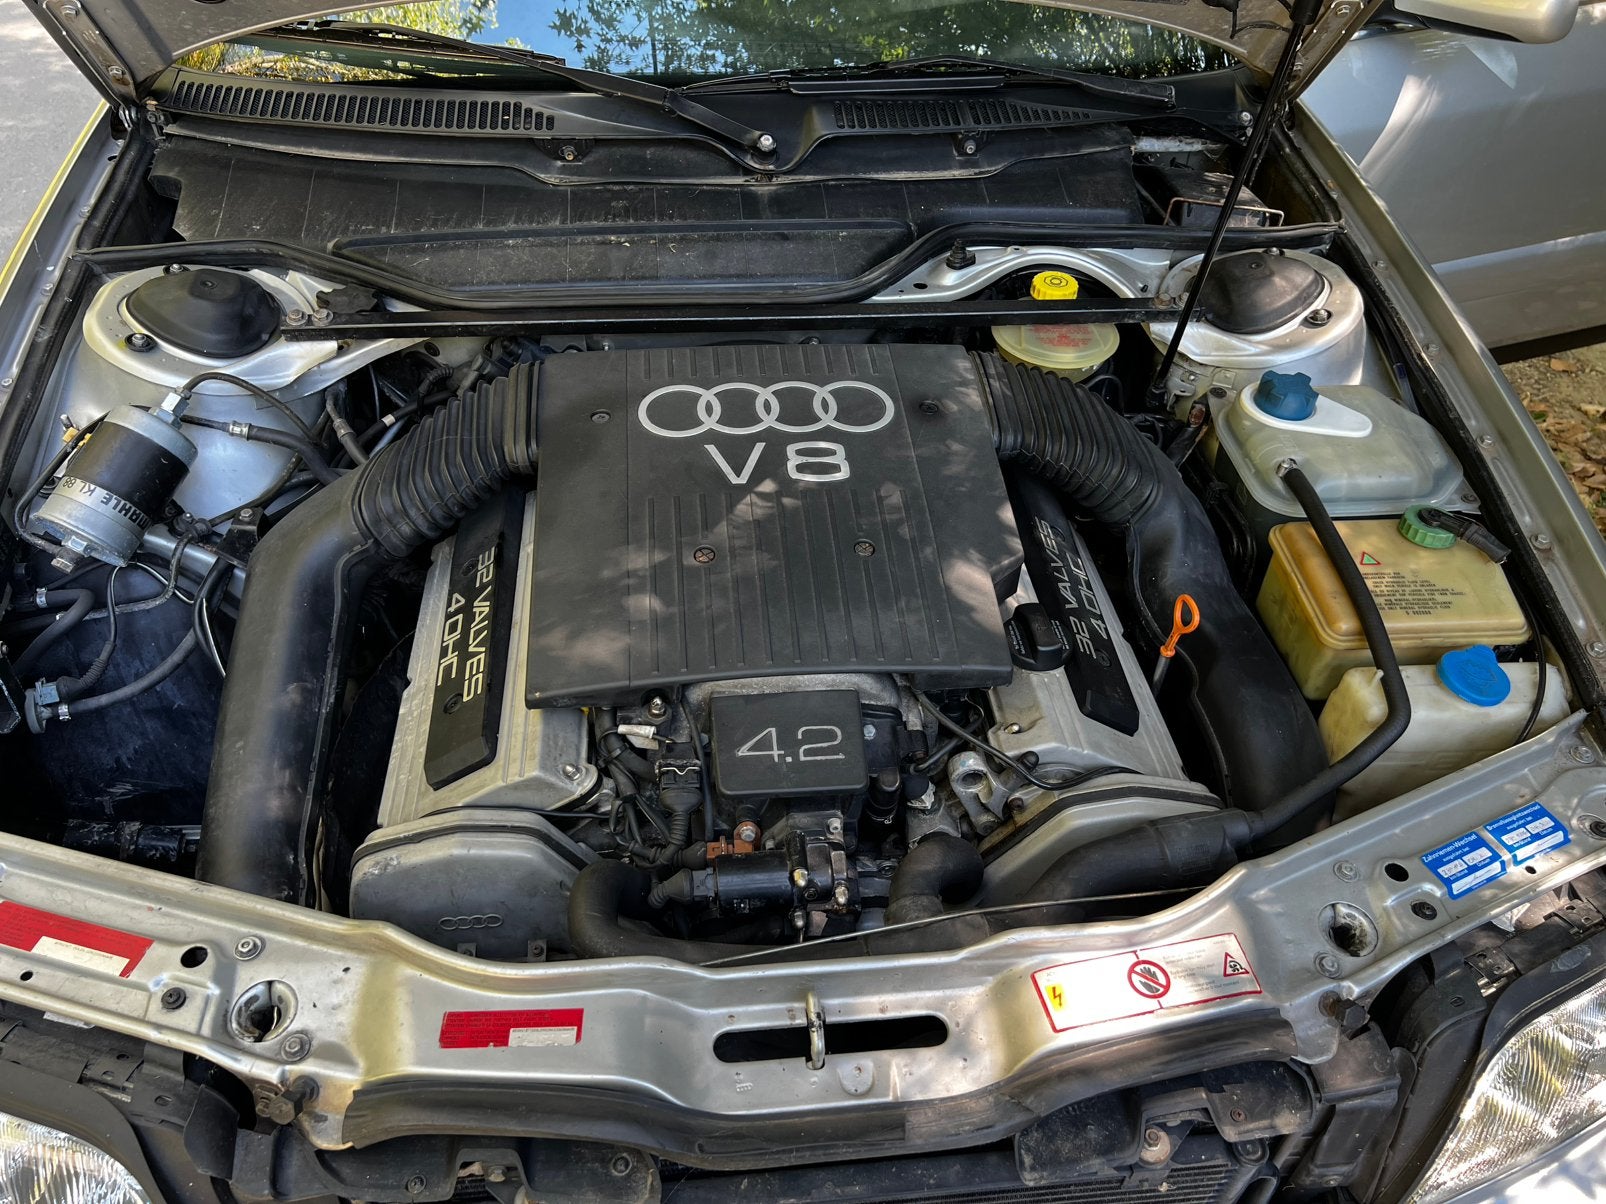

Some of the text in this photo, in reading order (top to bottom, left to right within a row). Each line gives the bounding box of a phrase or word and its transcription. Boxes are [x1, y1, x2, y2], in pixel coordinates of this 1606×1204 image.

[79, 480, 97, 497] KL
[101, 492, 152, 531] MAHLE
[1035, 516, 1079, 609] VALVES
[462, 546, 496, 703] 32 VALVES
[1069, 616, 1096, 659] 32
[735, 725, 846, 763] 4.2
